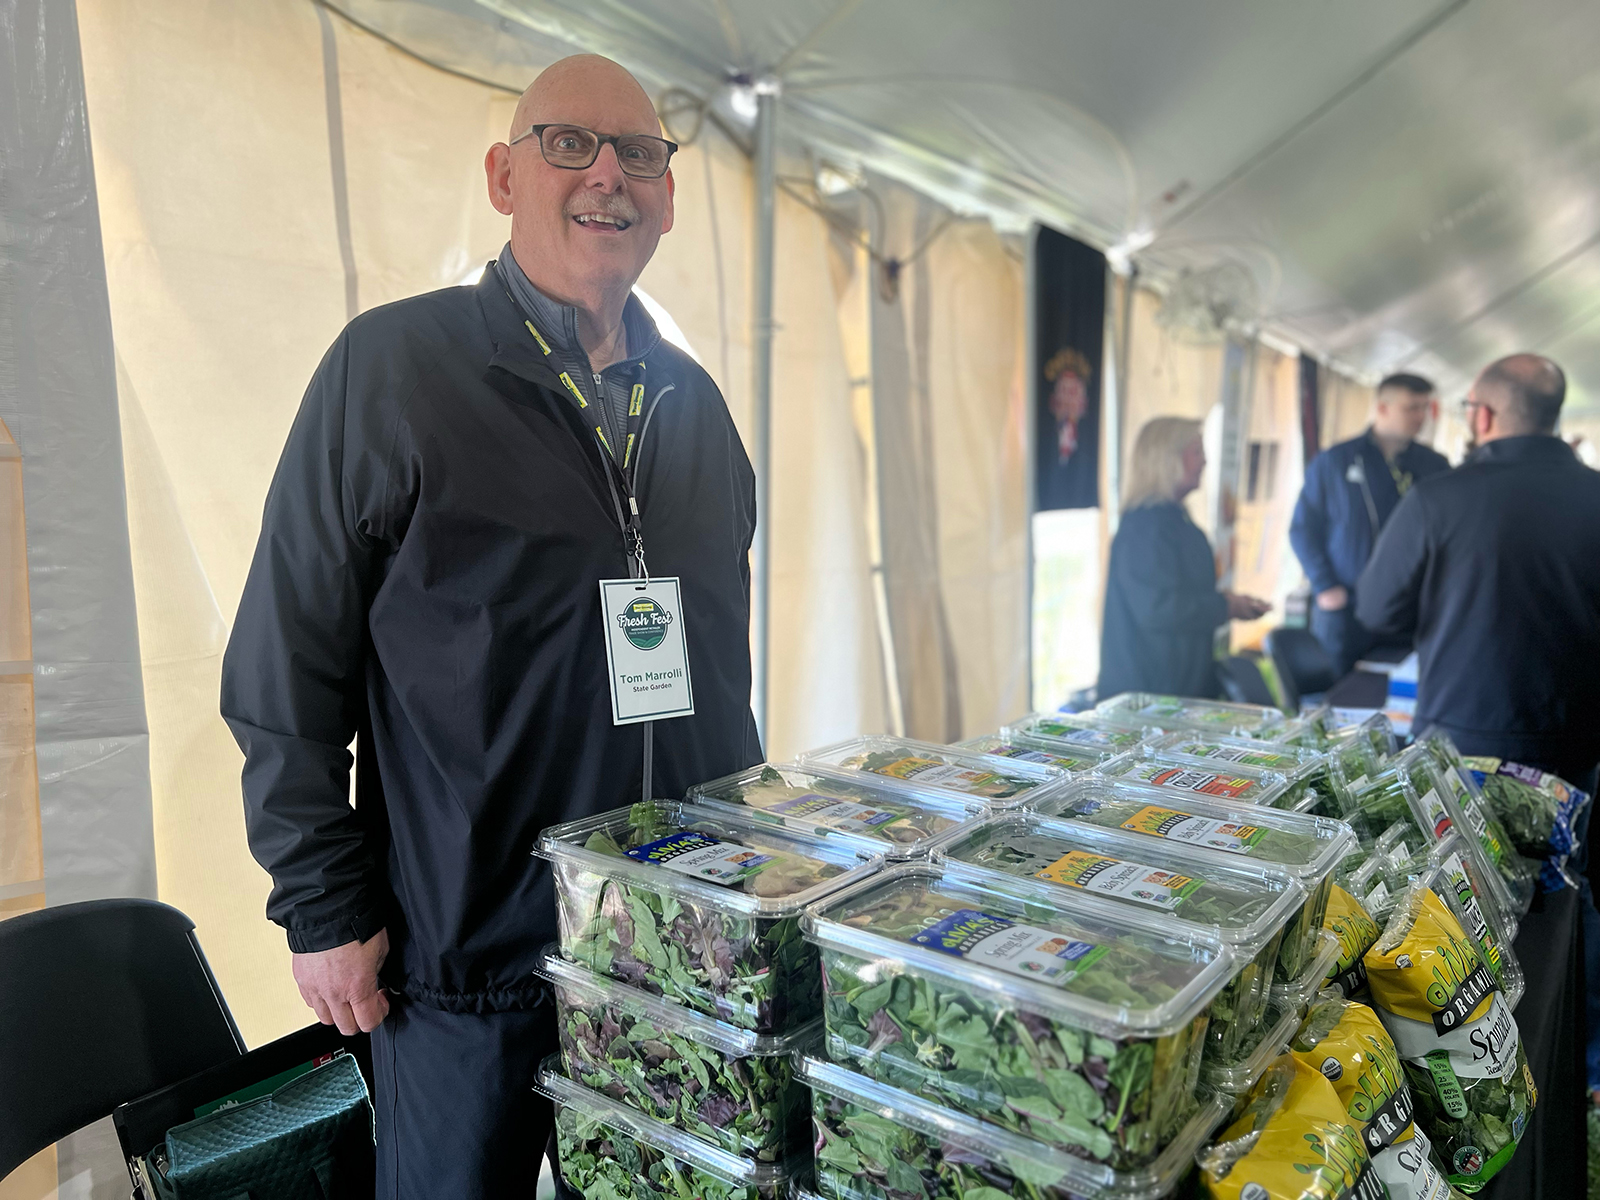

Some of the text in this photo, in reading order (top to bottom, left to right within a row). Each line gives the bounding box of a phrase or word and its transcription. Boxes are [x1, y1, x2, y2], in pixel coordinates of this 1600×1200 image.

[617, 611, 673, 627] Fresh Fest
[620, 668, 683, 684] Tom Marrolli
[632, 683, 672, 693] State Garden
[958, 921, 1010, 951] ORGANICS
[984, 936, 1020, 958] Spring
[1014, 931, 1033, 945] Mix
[1443, 1088, 1458, 1096] 40%
[1447, 1101, 1463, 1109] 15%
